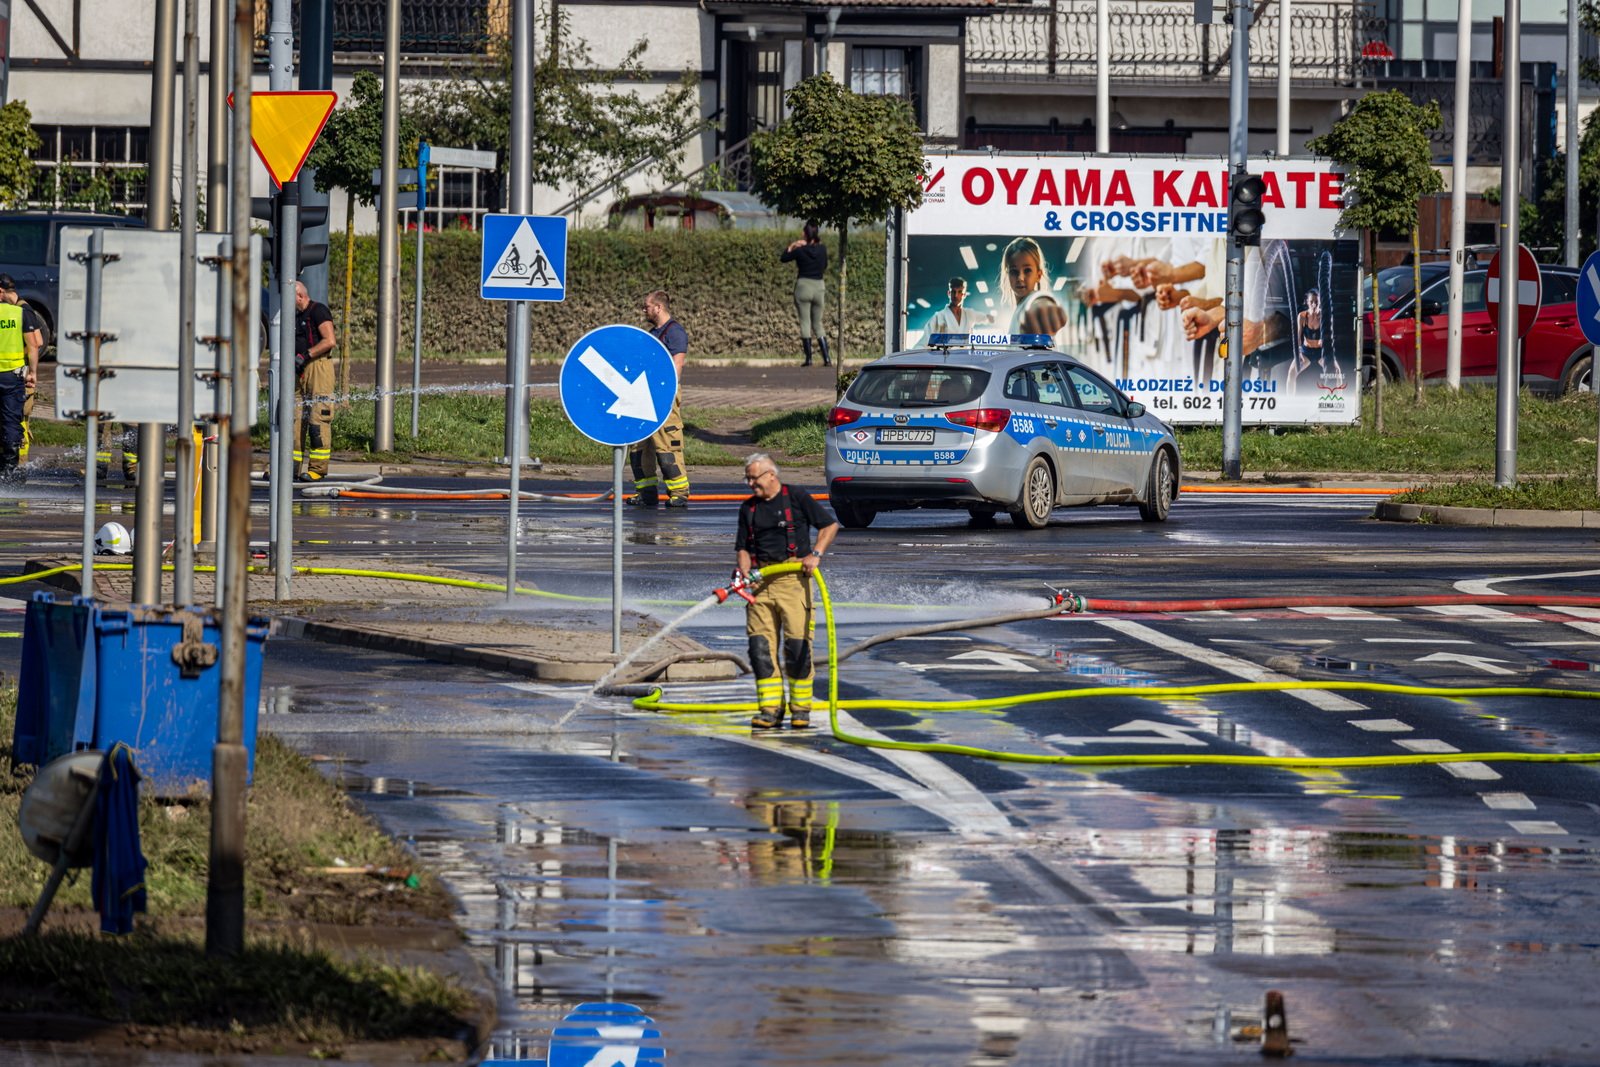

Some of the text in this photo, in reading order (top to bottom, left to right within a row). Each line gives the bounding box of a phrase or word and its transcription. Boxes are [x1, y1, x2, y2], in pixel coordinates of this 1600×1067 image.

[961, 166, 1345, 209] OYAMA KAATE
[1044, 211, 1062, 231] &
[970, 334, 1008, 344] POLICJA
[1115, 376, 1193, 392] MŁODZIEŻ
[1153, 396, 1178, 409] tel.
[1183, 397, 1211, 409] 602
[1249, 397, 1276, 410] 770
[1012, 418, 1035, 434] B588
[1105, 432, 1130, 449] POLICJA
[846, 450, 880, 461] POLICJA
[934, 451, 955, 460] B588
